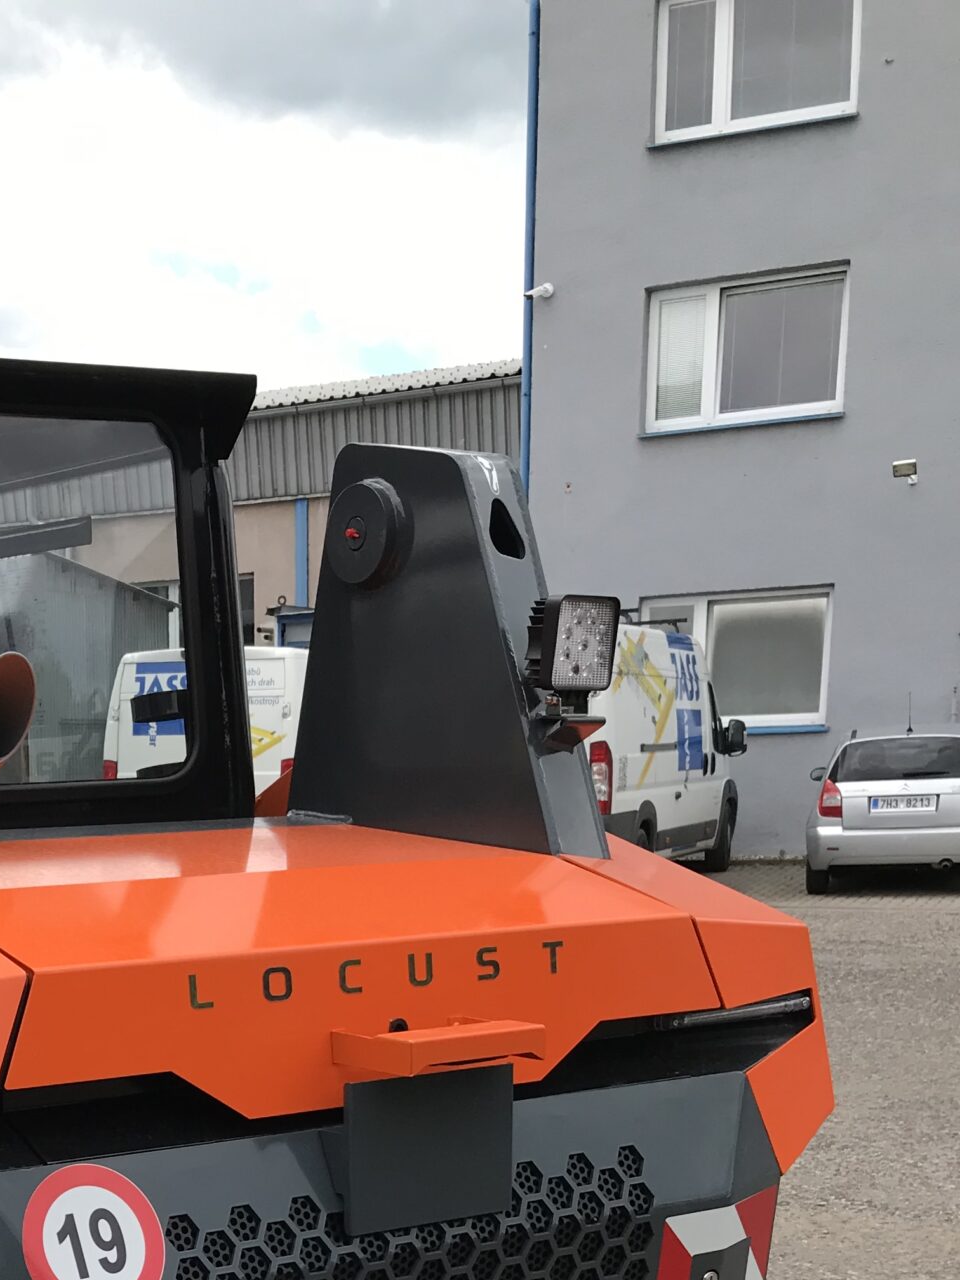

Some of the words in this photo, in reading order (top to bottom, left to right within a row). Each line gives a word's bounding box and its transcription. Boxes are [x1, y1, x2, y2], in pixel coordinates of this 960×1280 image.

[258, 678, 275, 687] drah
[670, 653, 700, 701] JASS
[880, 798, 899, 809] 7H3
[906, 797, 931, 808] 8213
[187, 940, 564, 1009] LOCUST
[56, 1207, 127, 1280] 19
